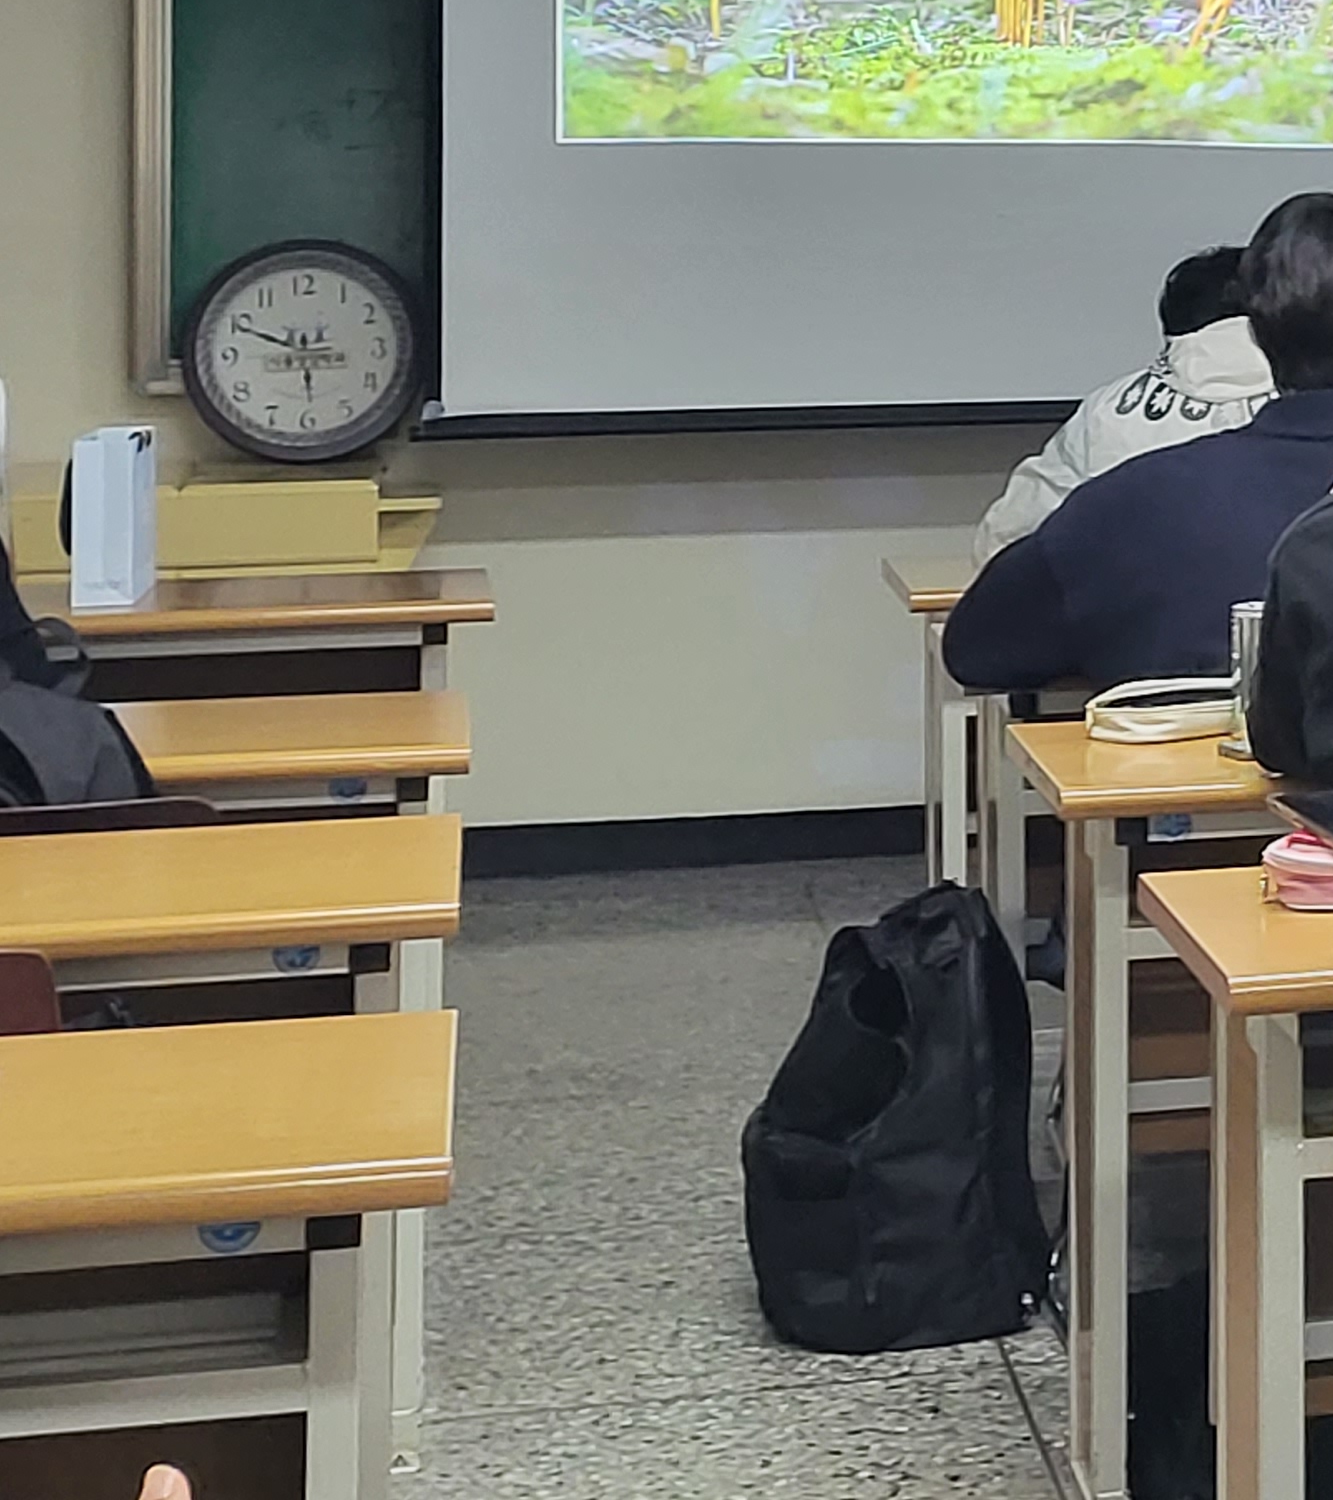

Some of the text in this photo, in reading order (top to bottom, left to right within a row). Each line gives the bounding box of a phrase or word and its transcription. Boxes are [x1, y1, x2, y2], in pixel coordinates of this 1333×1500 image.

[293, 274, 317, 296] 12
[258, 287, 273, 308] 11
[231, 313, 253, 335] 10
[363, 303, 376, 324] 2
[221, 347, 239, 367] 9
[370, 337, 387, 359] 3
[232, 381, 250, 402] 8
[363, 372, 377, 393] 4
[265, 405, 279, 426] 7
[300, 409, 316, 429] 6
[337, 400, 353, 419] 5
